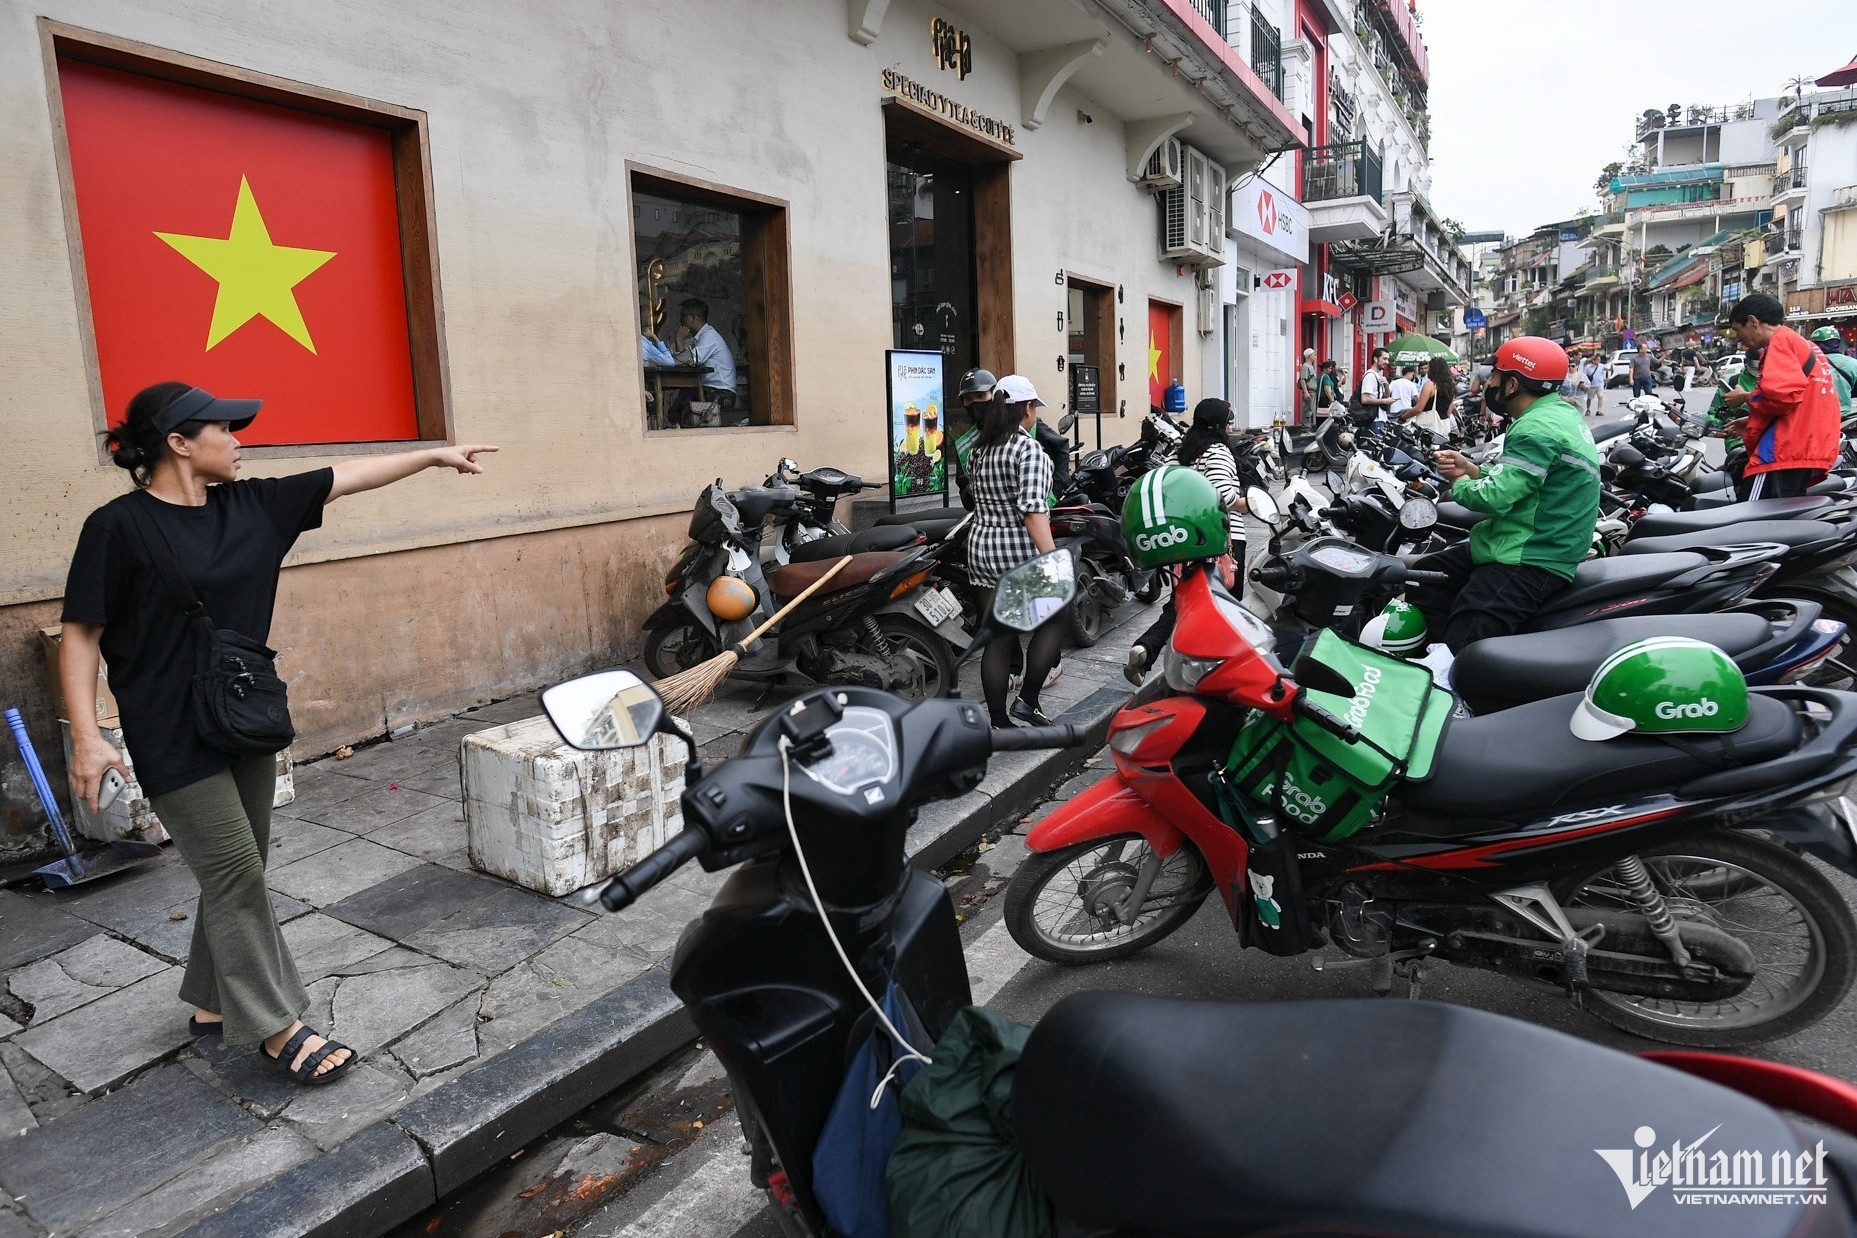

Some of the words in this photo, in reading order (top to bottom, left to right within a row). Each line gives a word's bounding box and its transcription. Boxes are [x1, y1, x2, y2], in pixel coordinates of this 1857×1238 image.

[882, 67, 948, 113] SPECIALTY
[947, 100, 970, 125] TEA
[970, 109, 978, 129] &
[1277, 211, 1293, 235] HSBC
[1322, 272, 1340, 306] KFC
[1136, 525, 1188, 551] Grab
[1655, 697, 1719, 719] Grab
[1546, 804, 1626, 828] RSX
[1297, 851, 1326, 860] NDA
